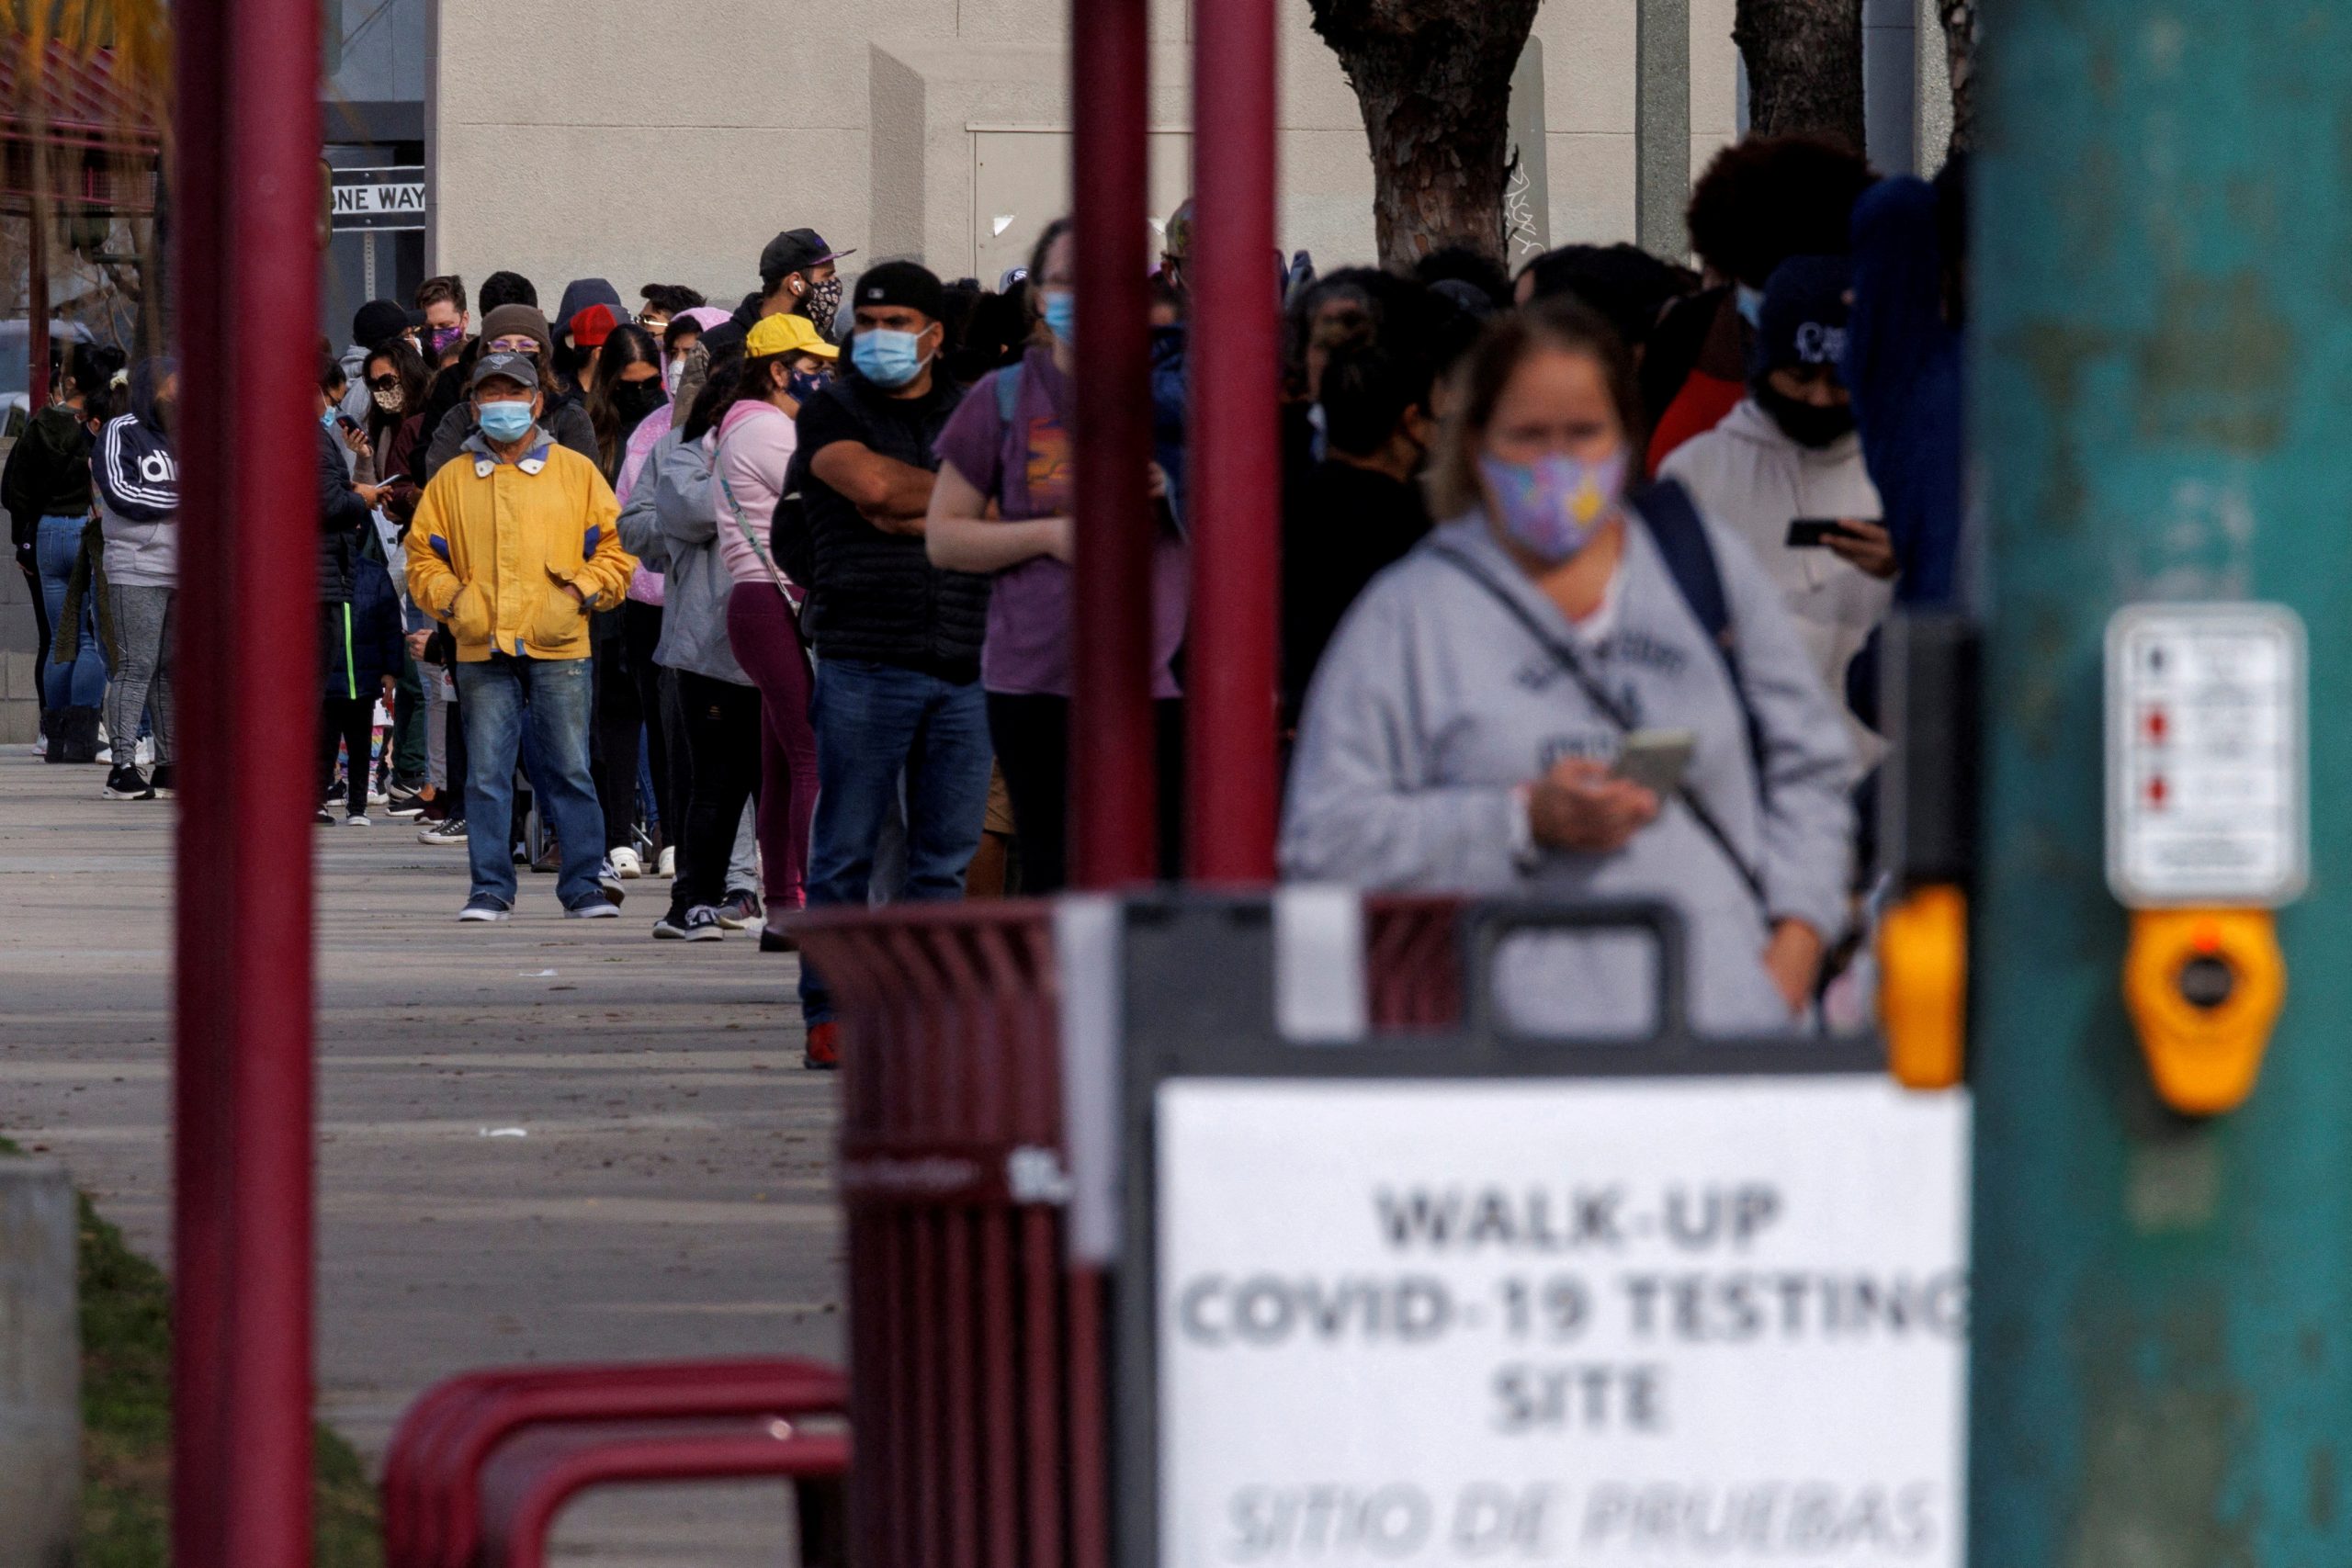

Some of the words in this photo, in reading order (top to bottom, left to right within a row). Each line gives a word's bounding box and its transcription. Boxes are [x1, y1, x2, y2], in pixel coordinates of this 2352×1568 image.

[333, 188, 369, 211] NE
[378, 186, 425, 209] WAY
[1377, 1185, 1781, 1249] WALK-UP
[1182, 1275, 1590, 1344] COVID-19
[1491, 1365, 1665, 1431] SITE
[1229, 1483, 1433, 1559] SITIO
[1452, 1483, 1561, 1556] DE
[1580, 1481, 1938, 1556] PRUEBAS
